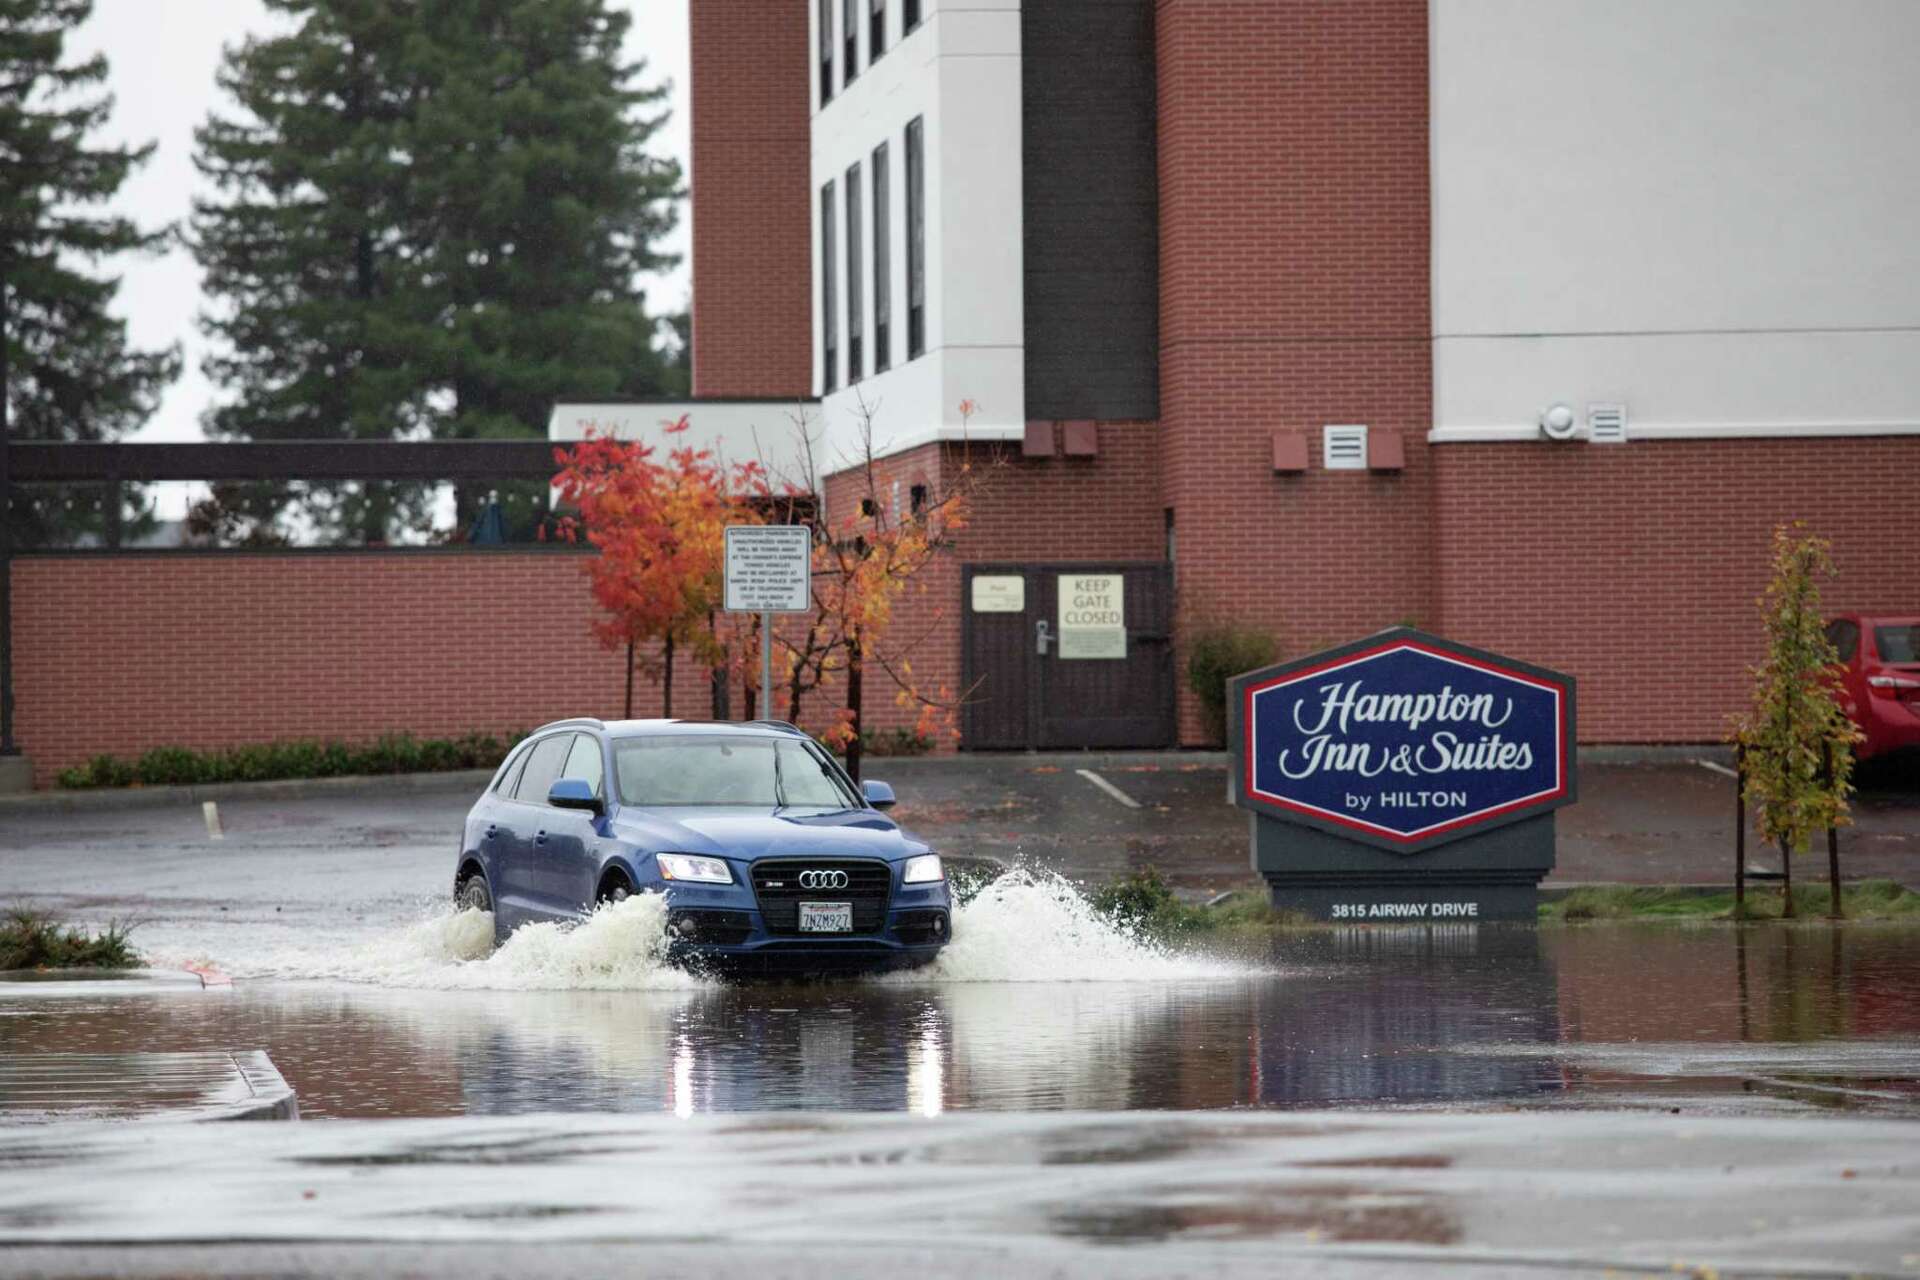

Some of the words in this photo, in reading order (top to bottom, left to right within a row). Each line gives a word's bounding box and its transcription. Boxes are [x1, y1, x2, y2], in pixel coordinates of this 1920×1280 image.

[1075, 579, 1111, 592] KEEP
[1073, 595, 1111, 608] GATE
[1065, 611, 1121, 624] CLOSED
[1294, 680, 1513, 735] Hampton
[1279, 734, 1390, 780] Inn
[1390, 744, 1418, 776] &
[1415, 731, 1534, 774] Suites
[1345, 792, 1372, 811] by
[1380, 791, 1467, 808] HILTON
[1332, 904, 1366, 917] 3815
[1369, 903, 1427, 917] AIRWAY
[1431, 903, 1478, 916] DRIVE
